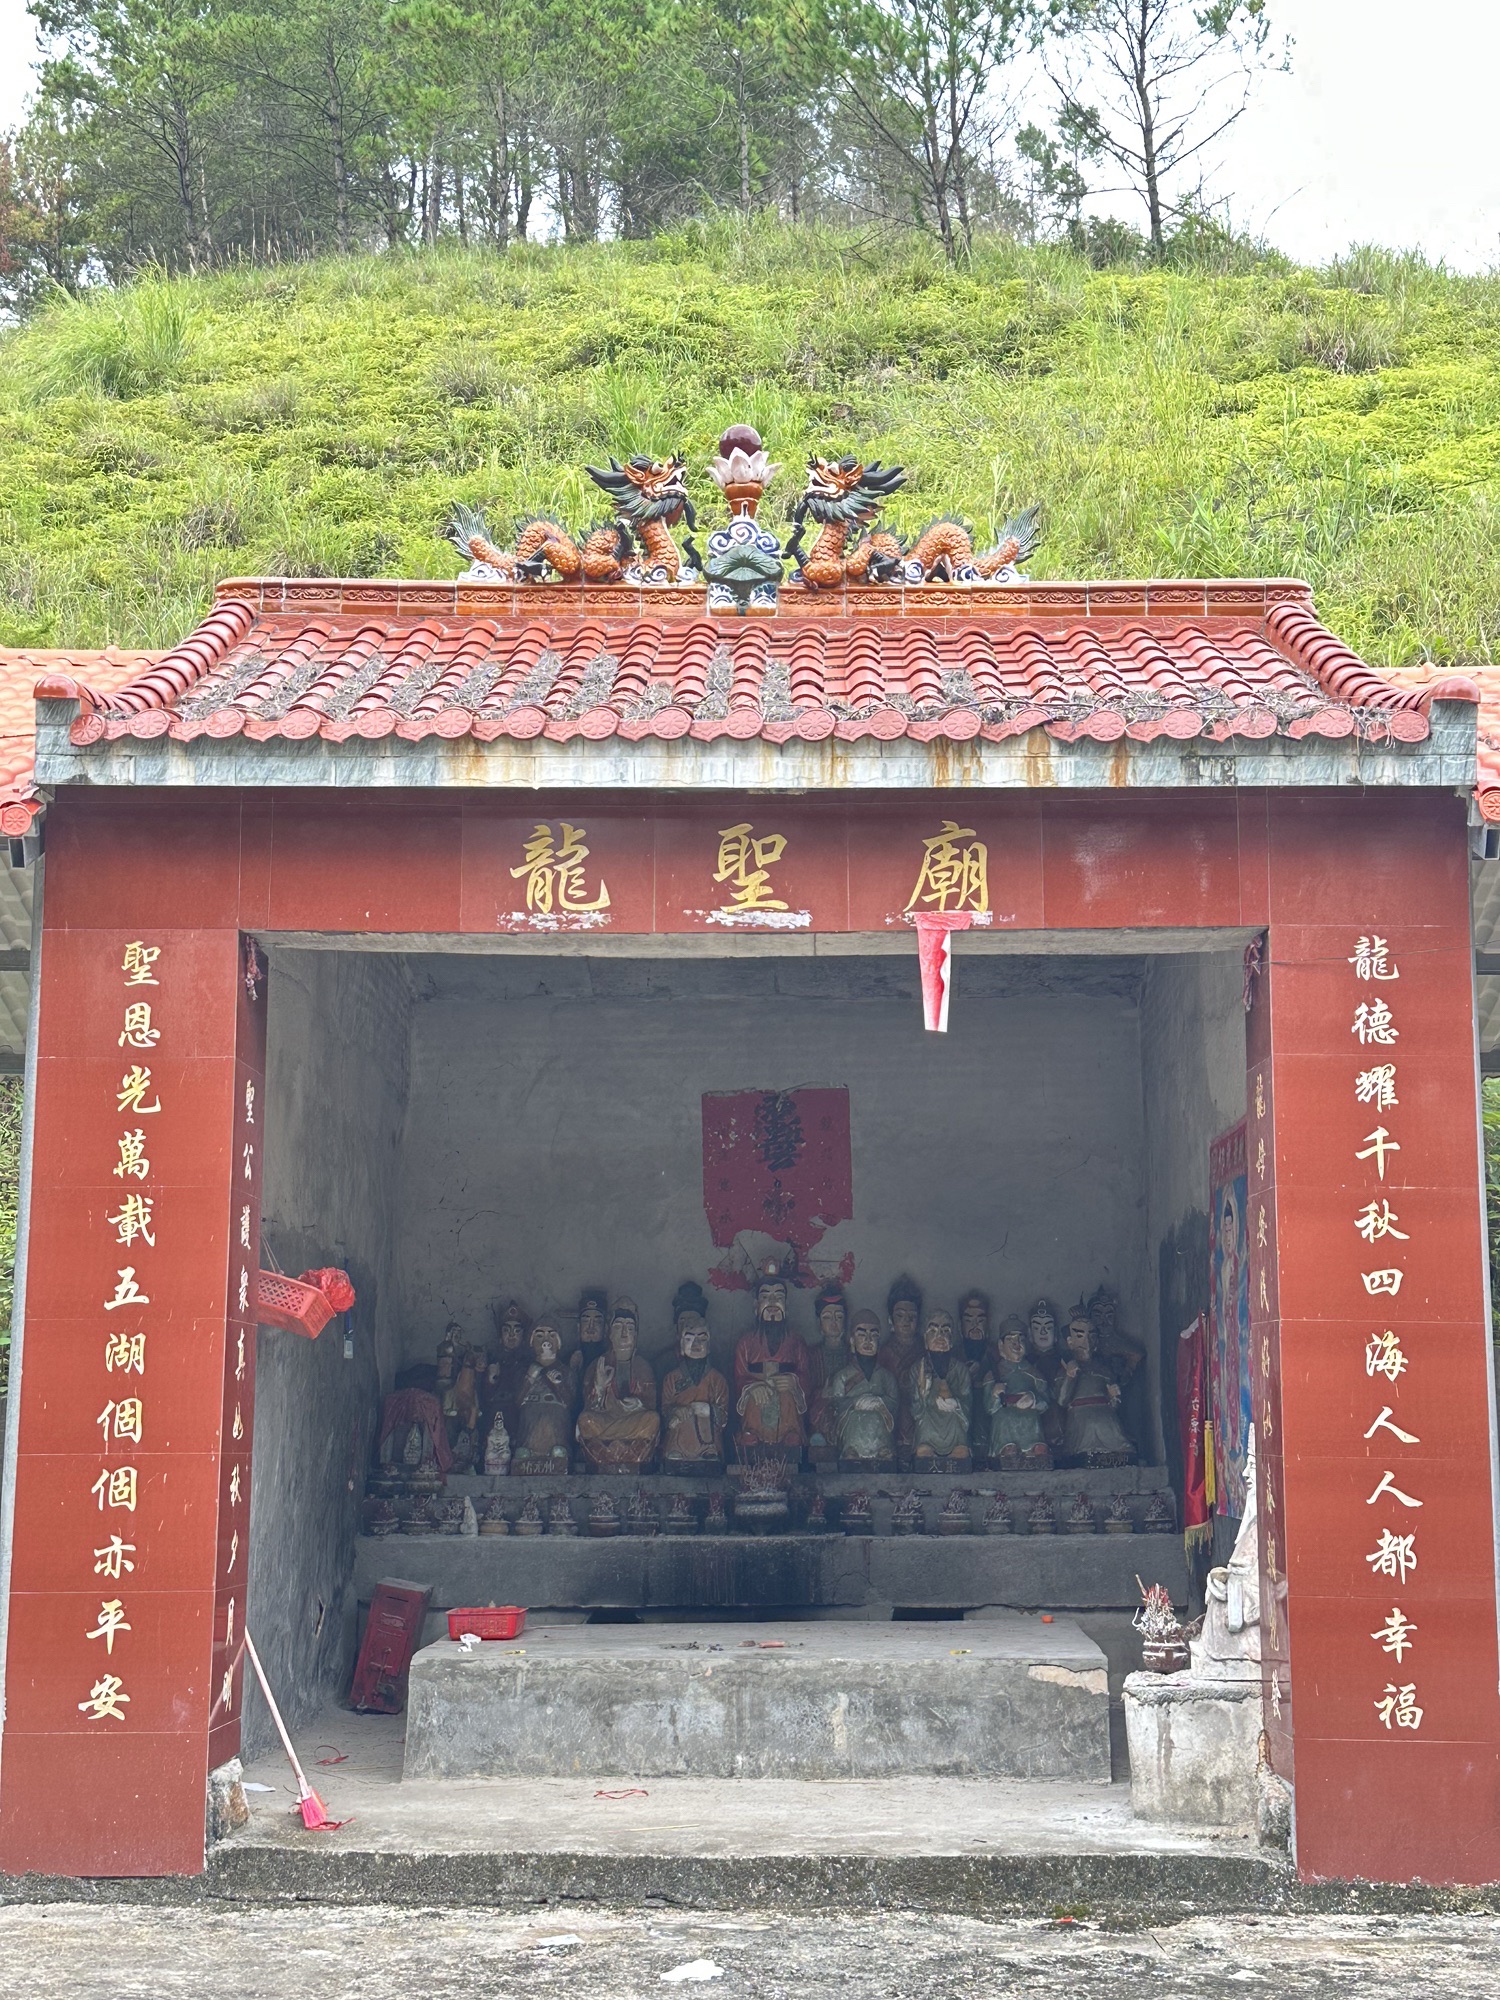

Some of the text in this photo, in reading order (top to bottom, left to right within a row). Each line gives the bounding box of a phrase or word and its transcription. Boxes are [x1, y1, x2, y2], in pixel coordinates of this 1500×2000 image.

[510, 820, 989, 914] 龍聖廟
[77, 940, 163, 1722] 聖恩光萬載五湖個個亦平安
[1347, 935, 1424, 1730] 龍德耀千秋四海人人都幸福
